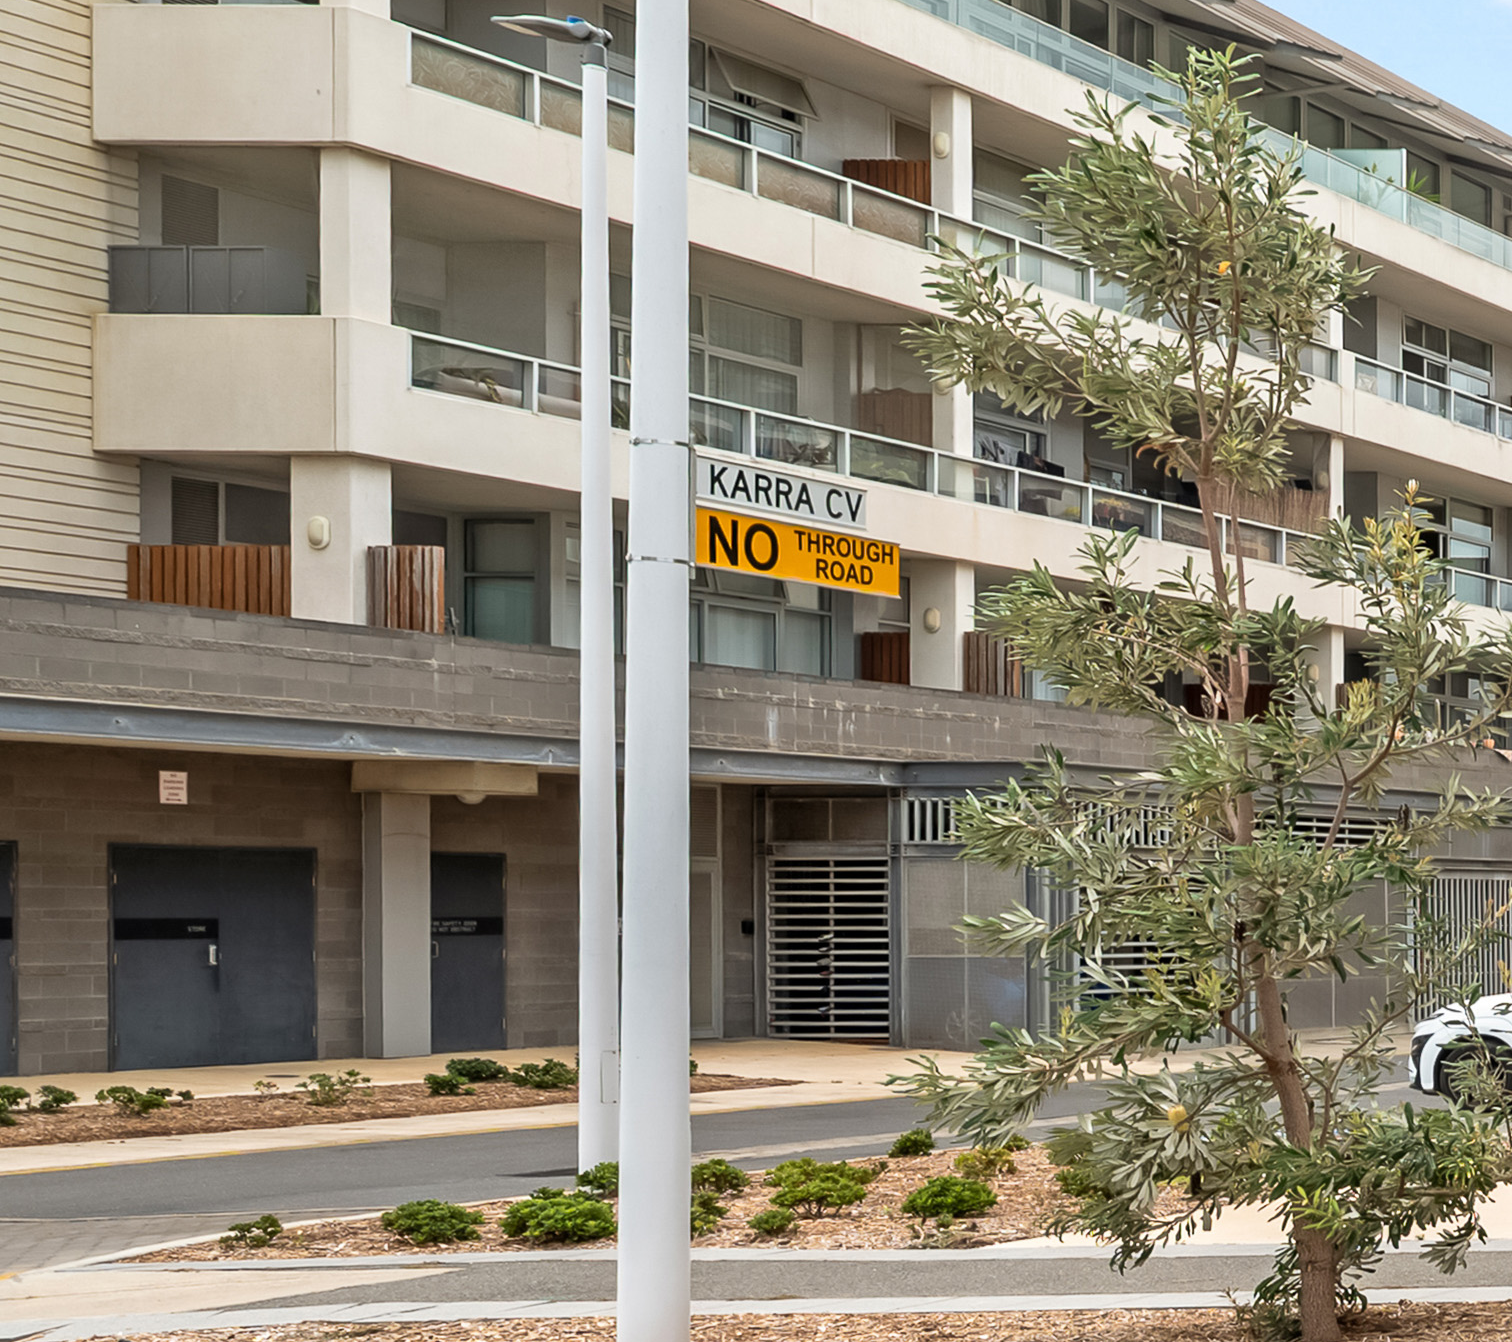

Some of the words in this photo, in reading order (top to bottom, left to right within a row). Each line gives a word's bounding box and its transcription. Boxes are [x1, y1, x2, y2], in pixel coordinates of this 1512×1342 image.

[710, 464, 815, 515] KARRA
[826, 488, 863, 522] CV
[709, 515, 779, 571] NO
[794, 530, 894, 565] THROUGH
[816, 558, 873, 585] ROAD
